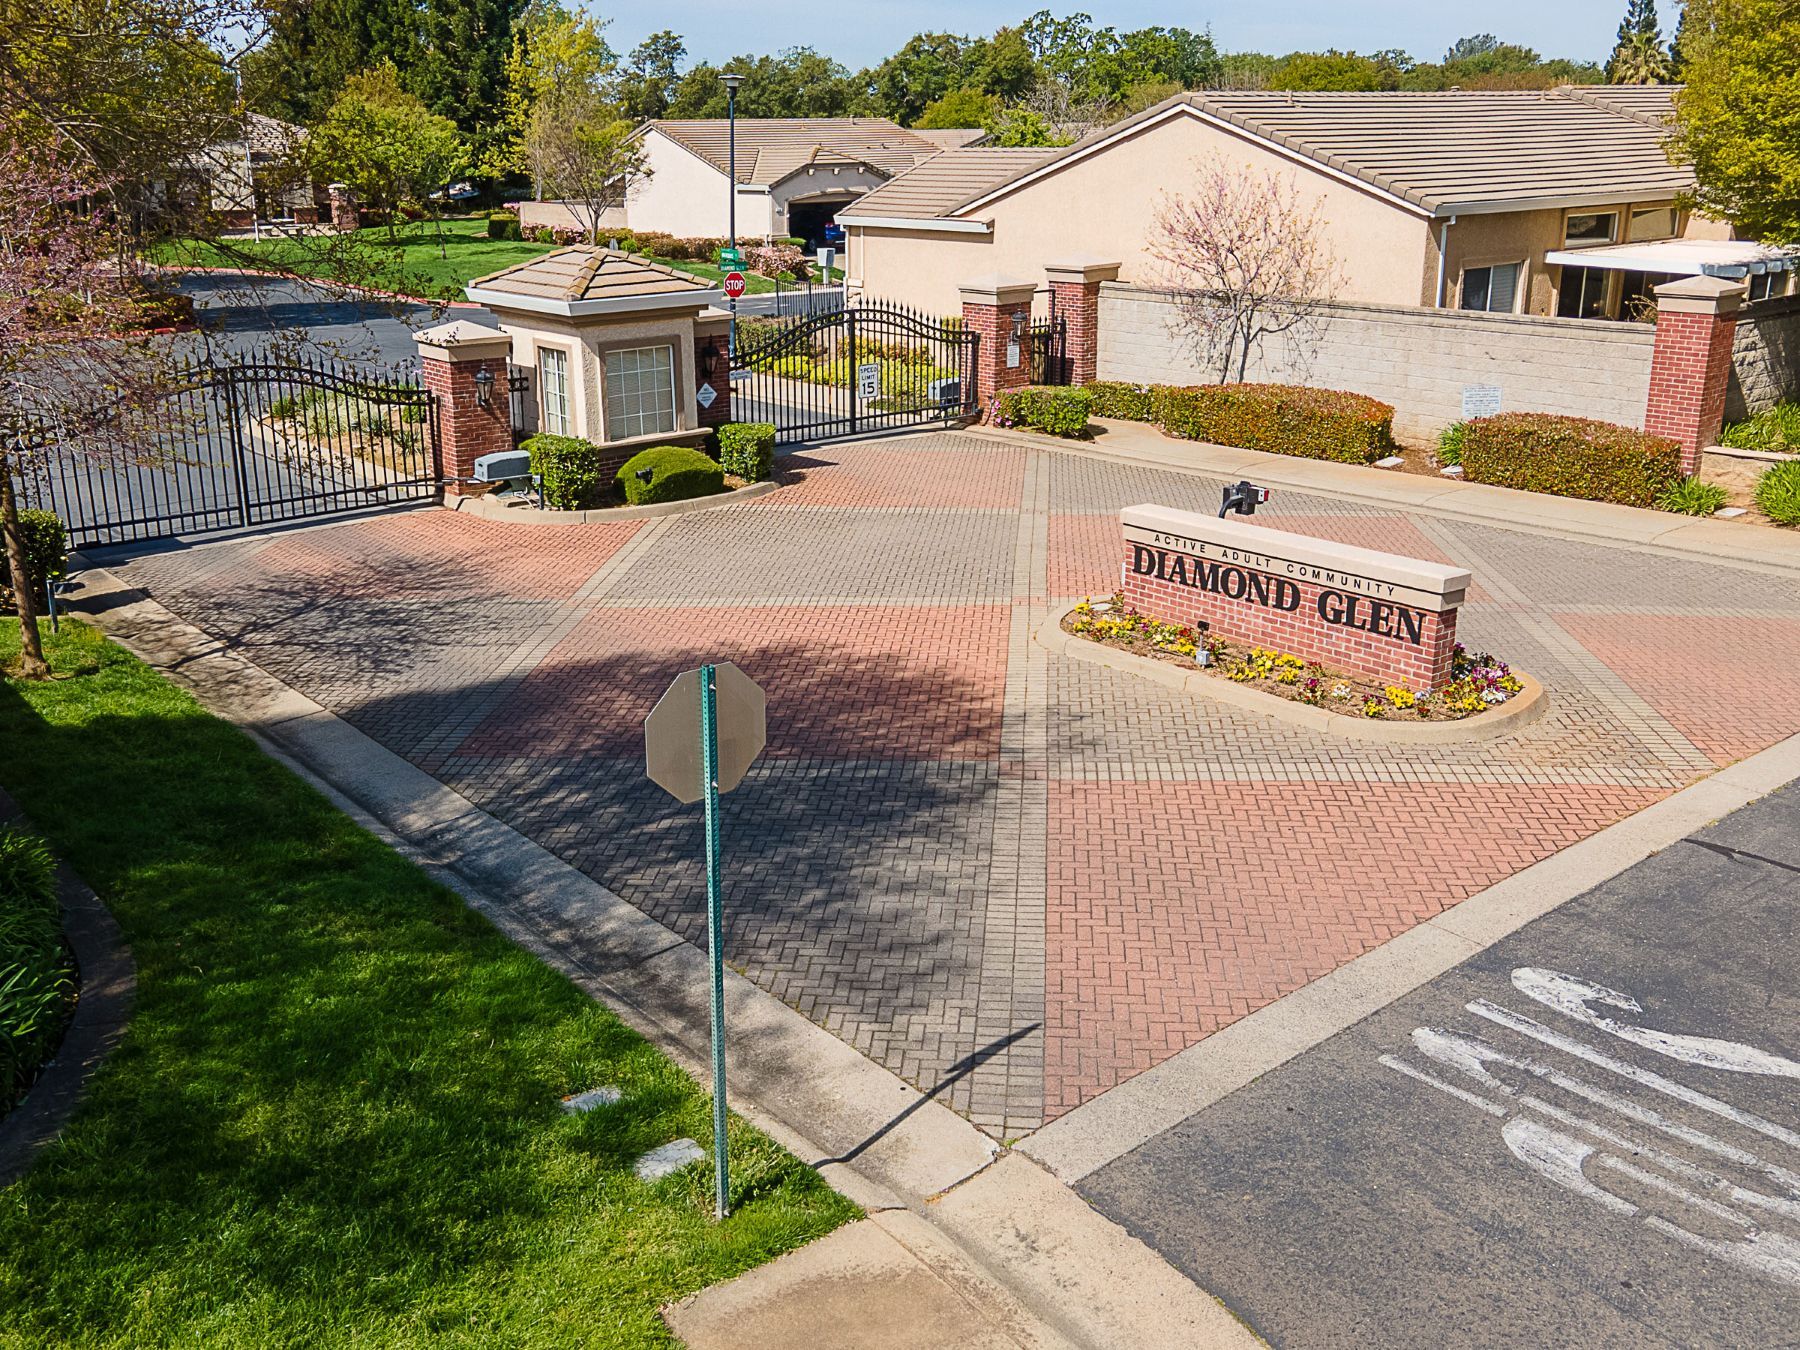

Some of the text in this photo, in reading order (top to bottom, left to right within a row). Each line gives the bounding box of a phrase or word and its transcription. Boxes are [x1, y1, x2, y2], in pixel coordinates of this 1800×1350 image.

[726, 280, 744, 290] STOP
[862, 382, 875, 394] 15
[1154, 534, 1395, 596] ACTIVE ADULT COMMUNITY
[1132, 545, 1427, 646] DIAMOND GLEN
